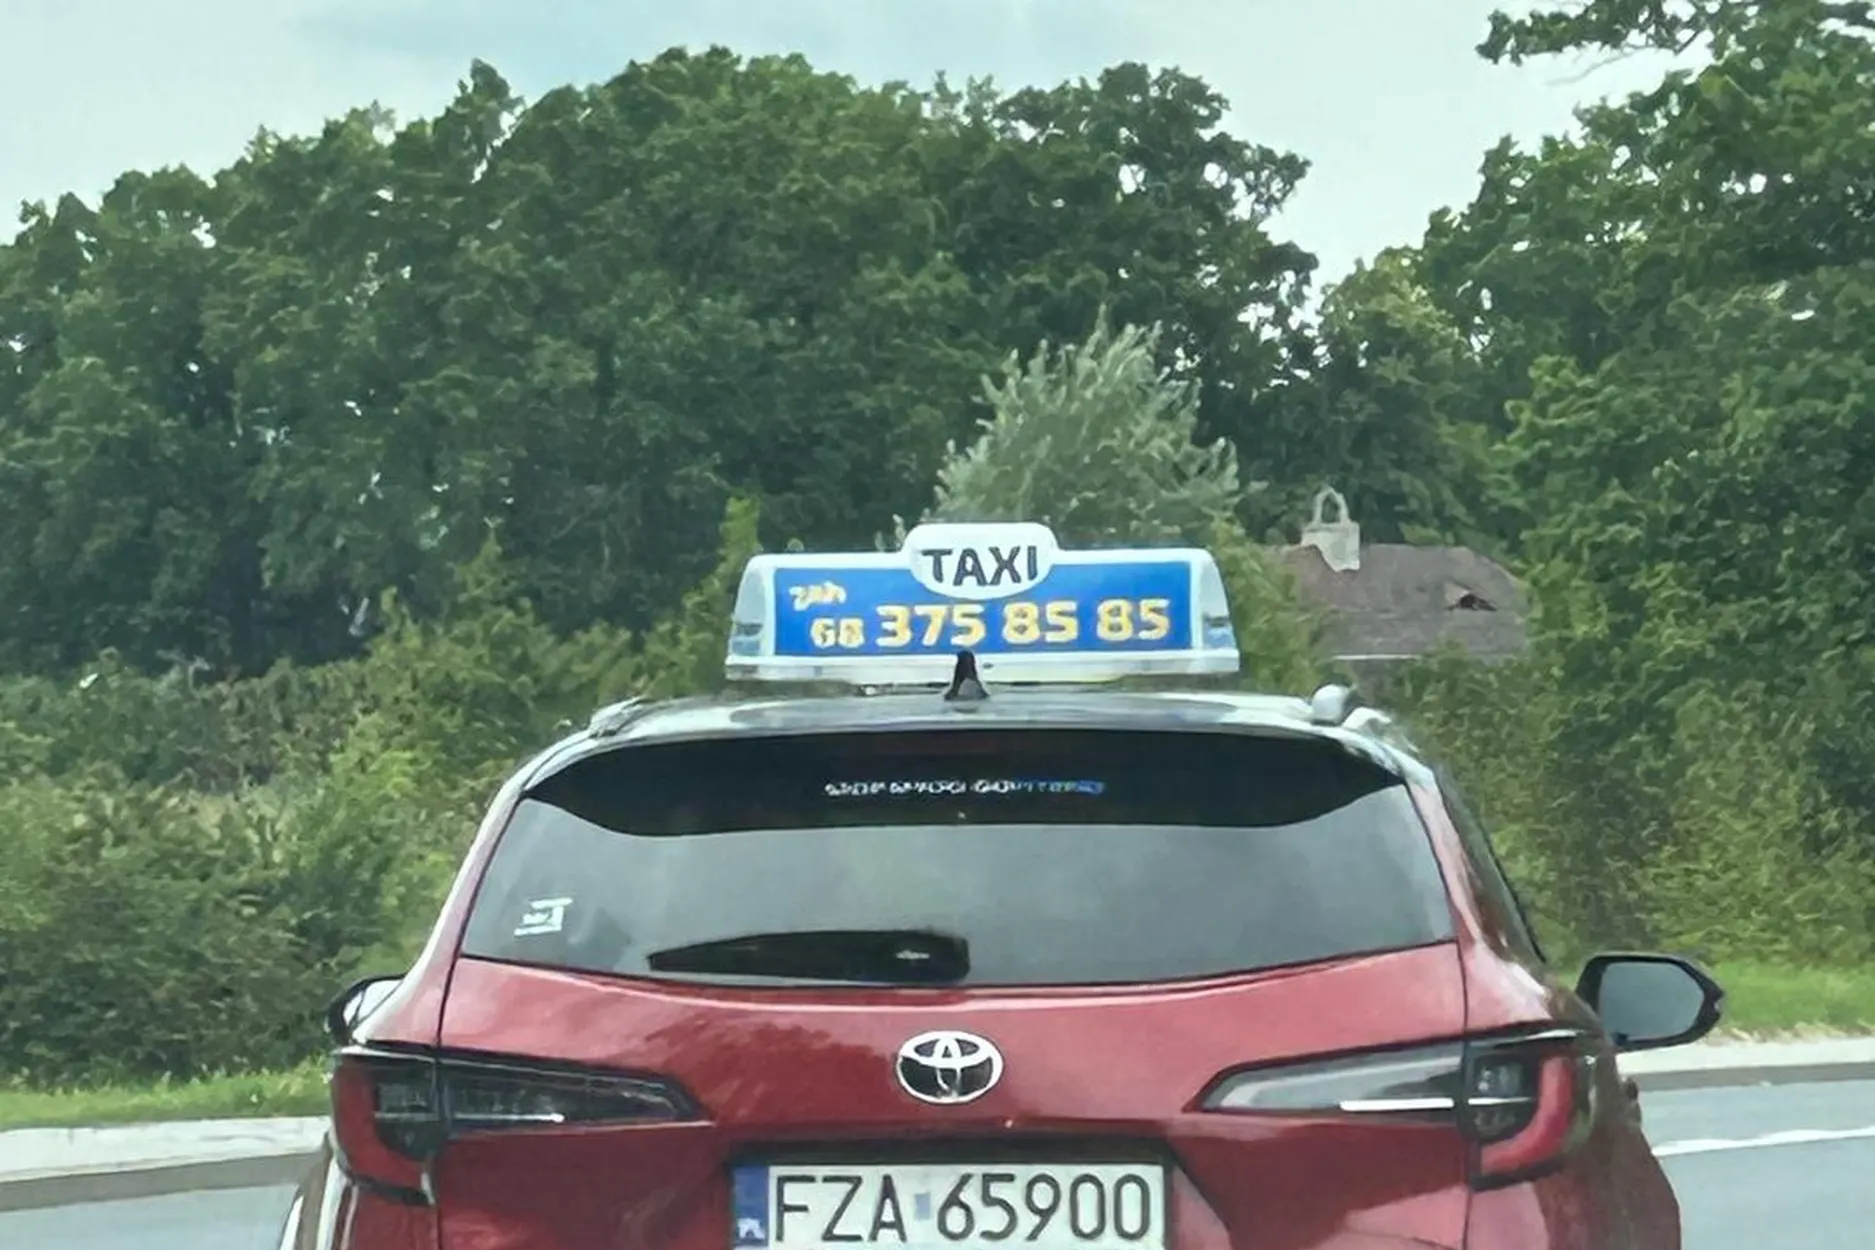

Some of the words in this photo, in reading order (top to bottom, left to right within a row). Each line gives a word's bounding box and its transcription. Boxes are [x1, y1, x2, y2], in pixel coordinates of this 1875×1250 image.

[921, 545, 1038, 586] TAXI
[876, 603, 986, 647] 375
[1002, 601, 1078, 645] 85
[1096, 598, 1170, 642] 85
[775, 1174, 907, 1243] FZA
[936, 1173, 1152, 1242] 65900
